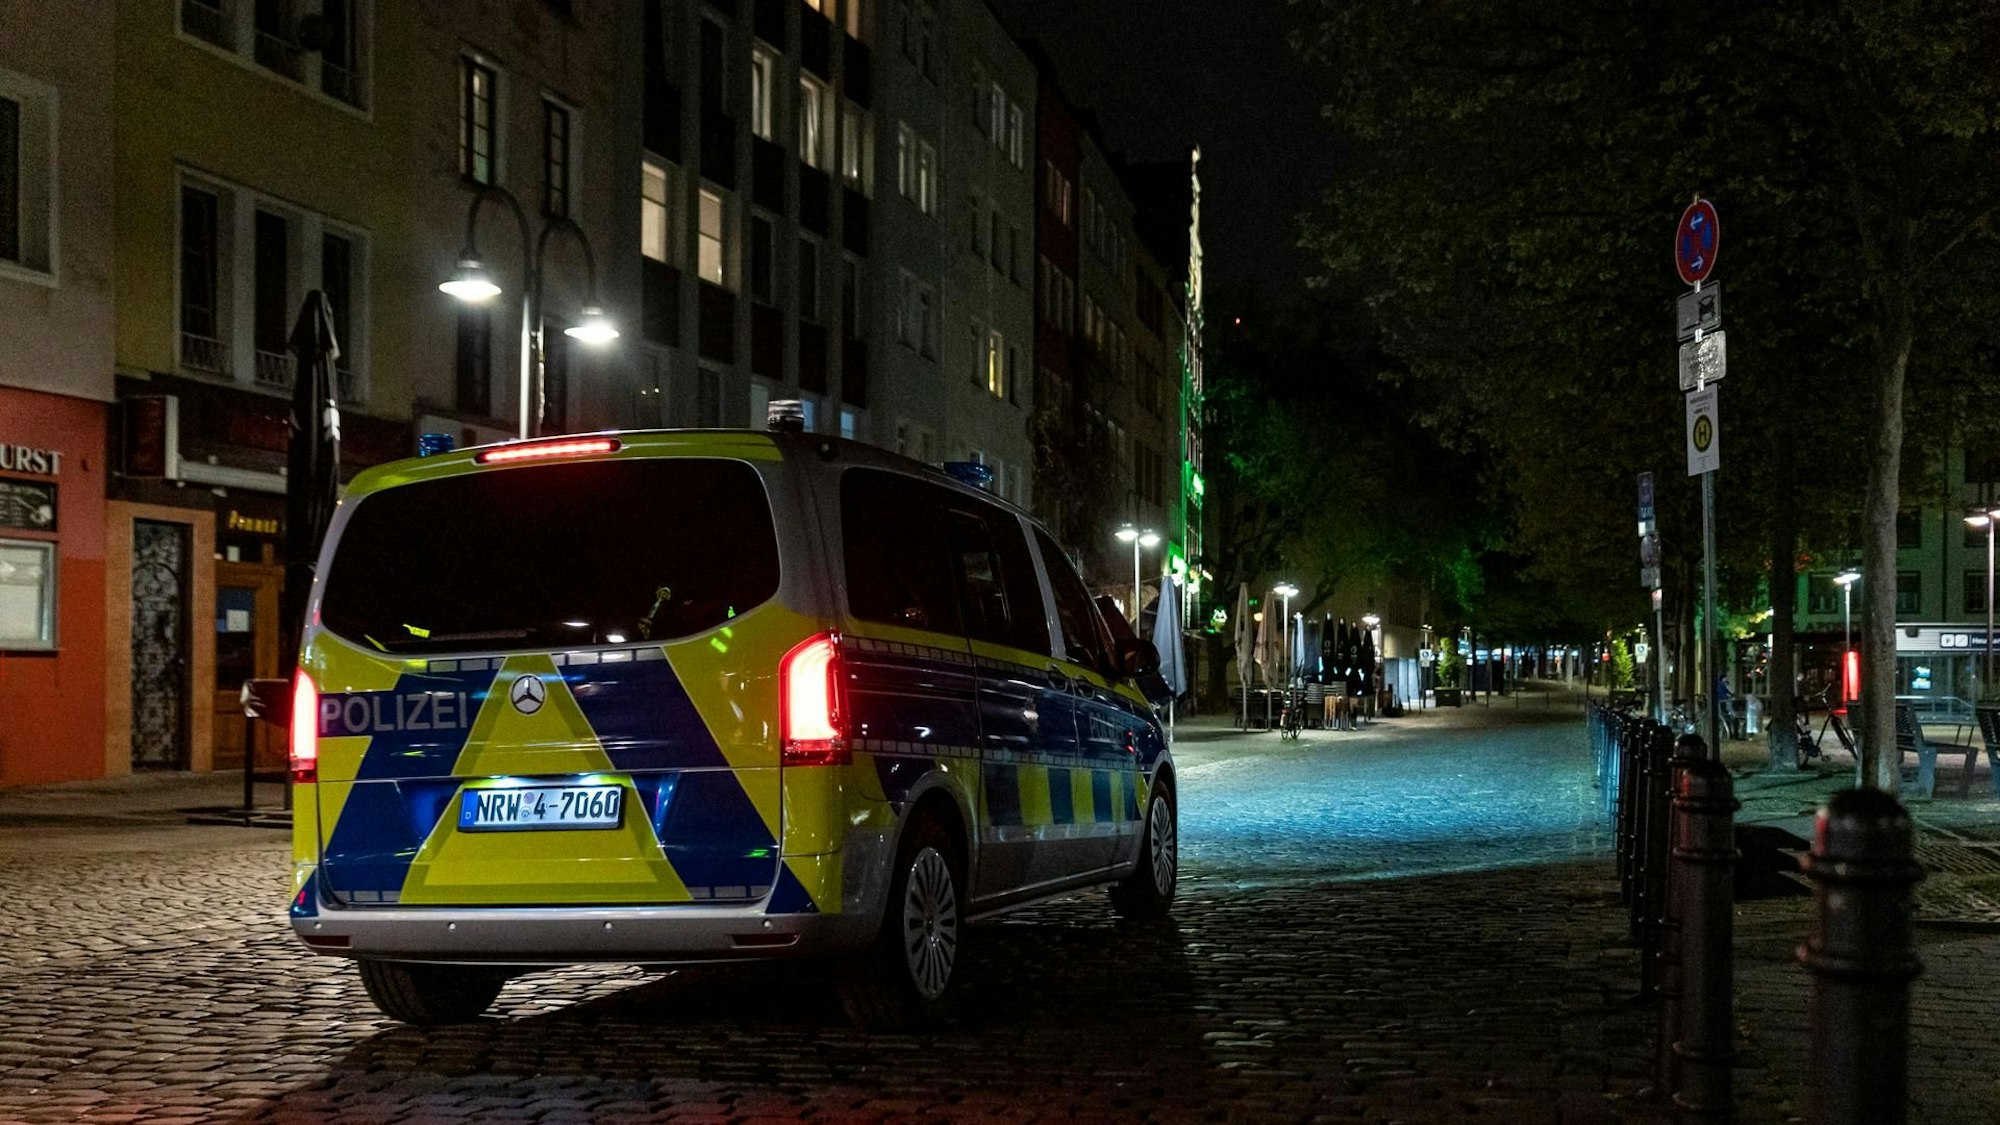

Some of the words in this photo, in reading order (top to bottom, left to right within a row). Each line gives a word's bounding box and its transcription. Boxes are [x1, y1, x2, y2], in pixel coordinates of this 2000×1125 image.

[0, 444, 65, 475] URST
[320, 692, 468, 733] POLIZEI
[476, 794, 521, 822] NRW
[533, 790, 619, 820] 4-7060
